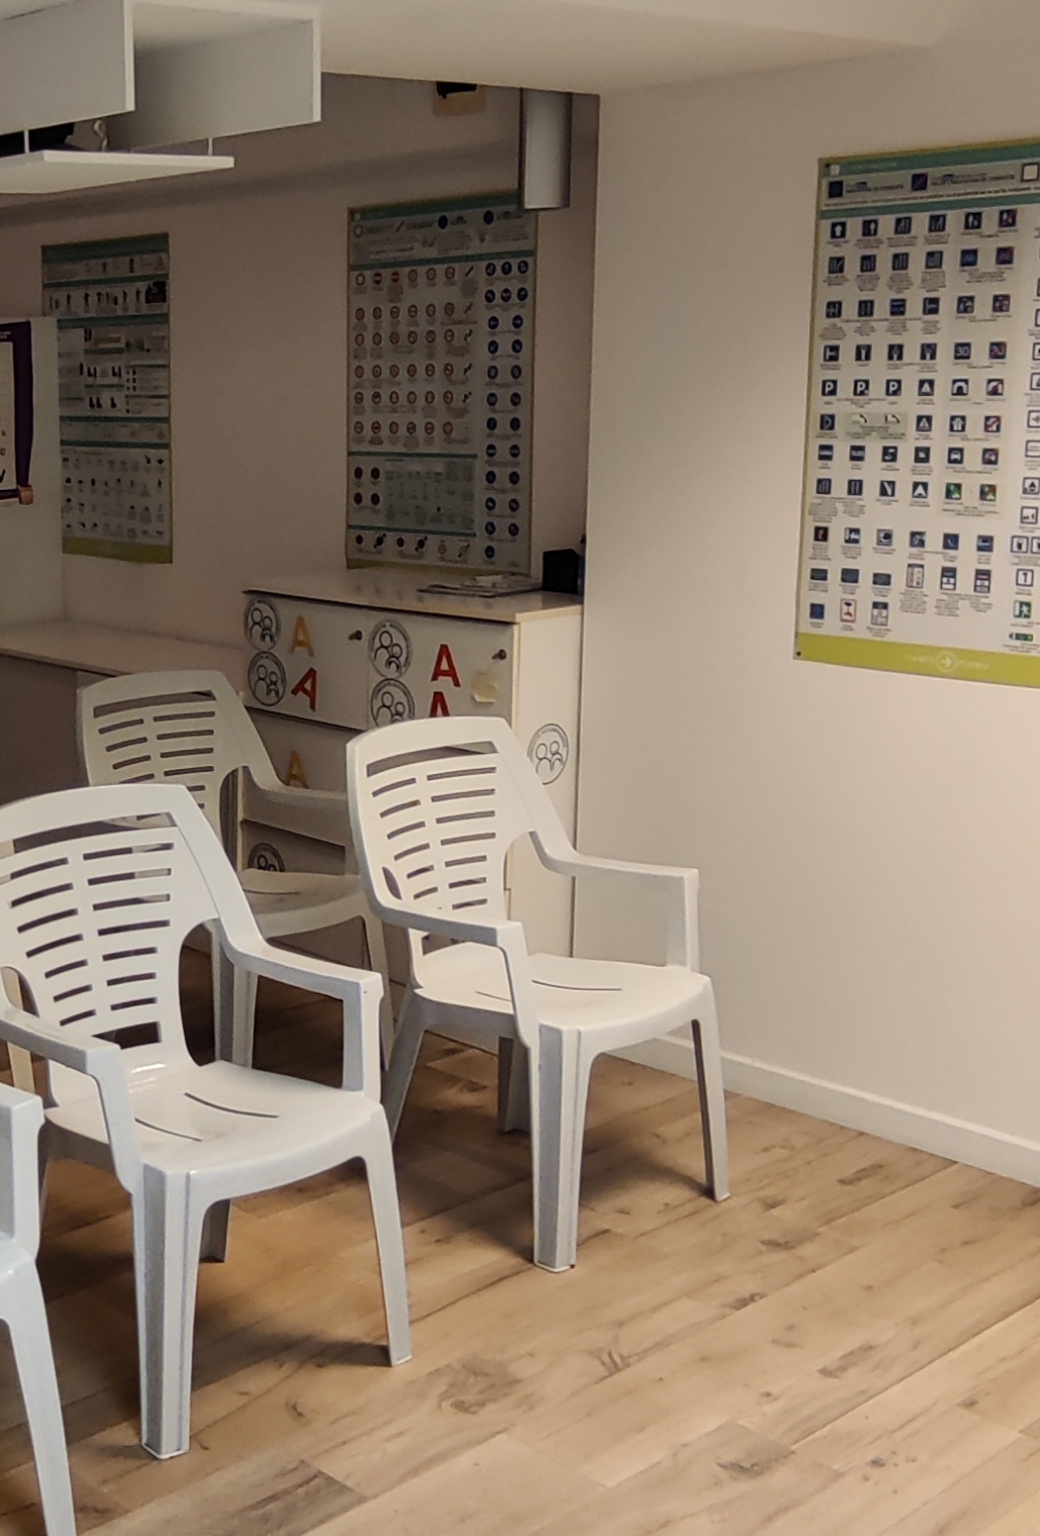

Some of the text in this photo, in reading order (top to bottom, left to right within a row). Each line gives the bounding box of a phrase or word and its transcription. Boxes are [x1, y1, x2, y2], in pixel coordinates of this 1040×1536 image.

[956, 346, 969, 357] 30
[291, 616, 314, 657] A
[430, 643, 461, 688] A
[291, 667, 318, 712] A
[284, 750, 310, 789] A
